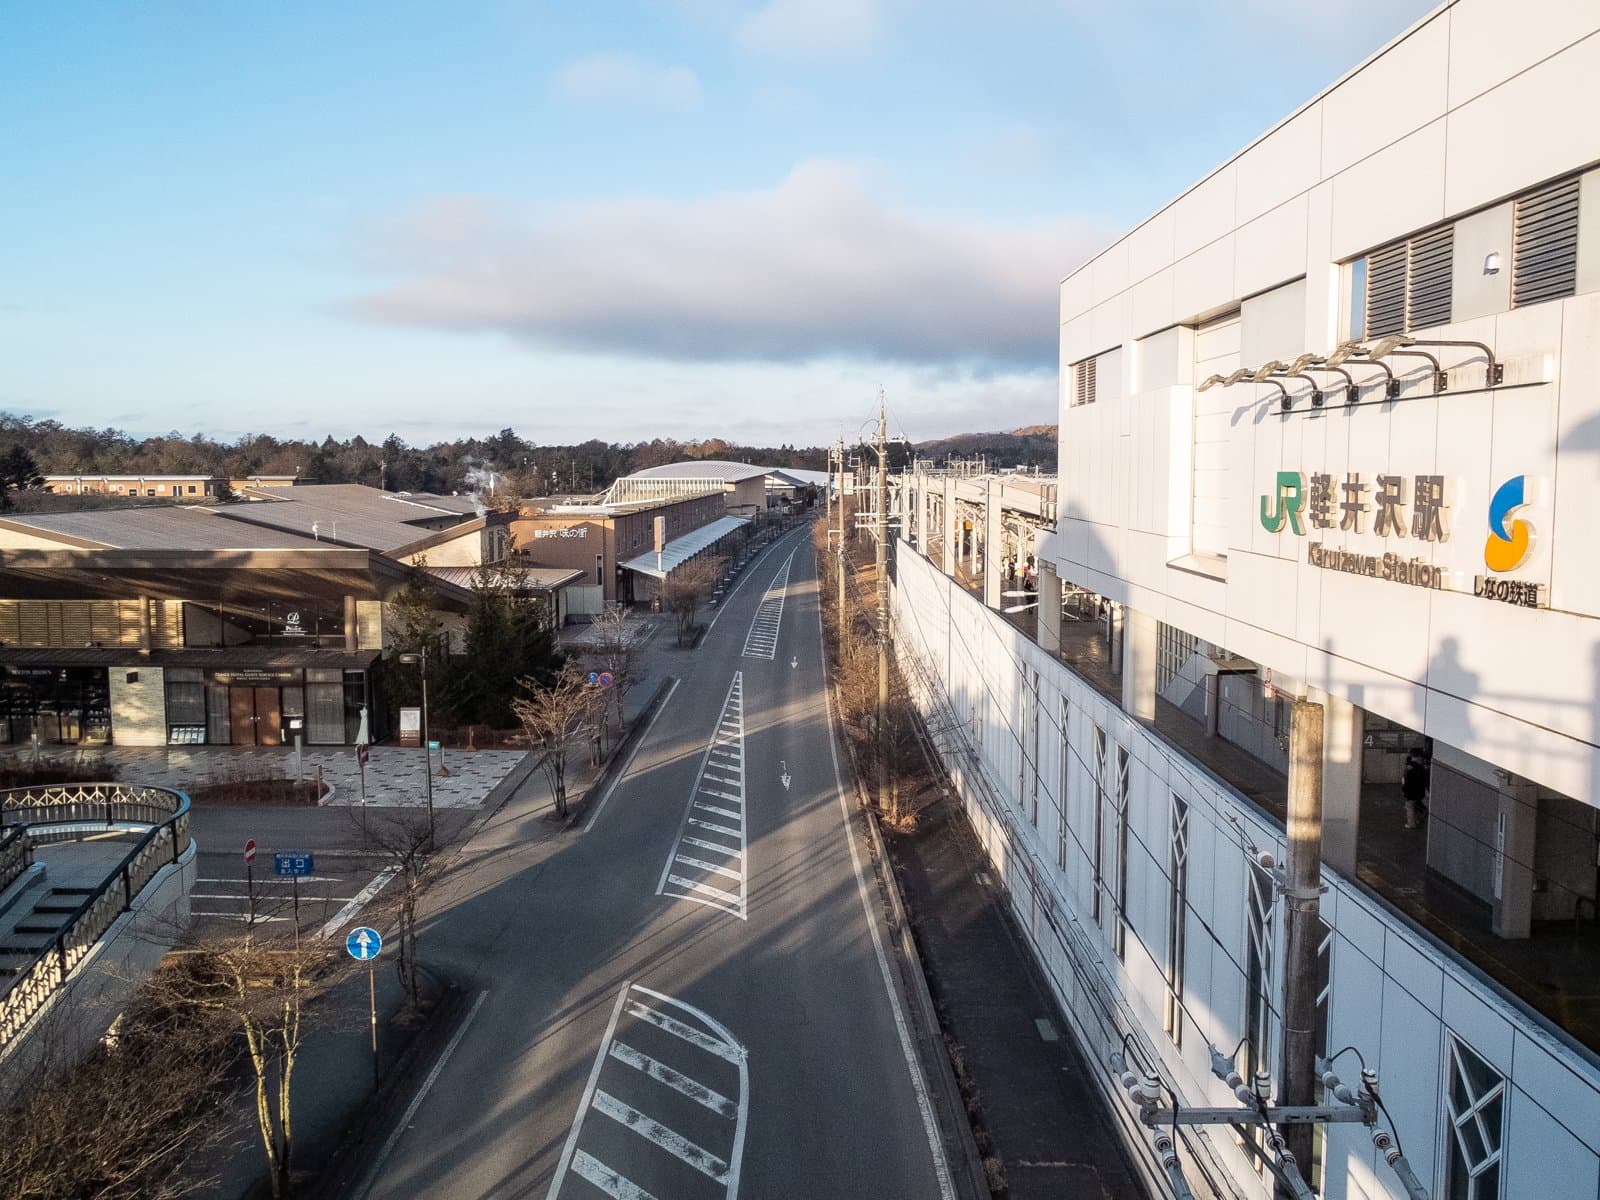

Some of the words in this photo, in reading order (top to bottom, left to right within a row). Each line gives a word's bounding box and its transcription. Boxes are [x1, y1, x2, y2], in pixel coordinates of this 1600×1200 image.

[1260, 472, 1305, 535] JR
[1309, 472, 1448, 542] 軽井沢駅
[1308, 541, 1379, 578] Karuizawa
[1383, 552, 1442, 589] Station
[1474, 575, 1539, 609] しなの鉄道
